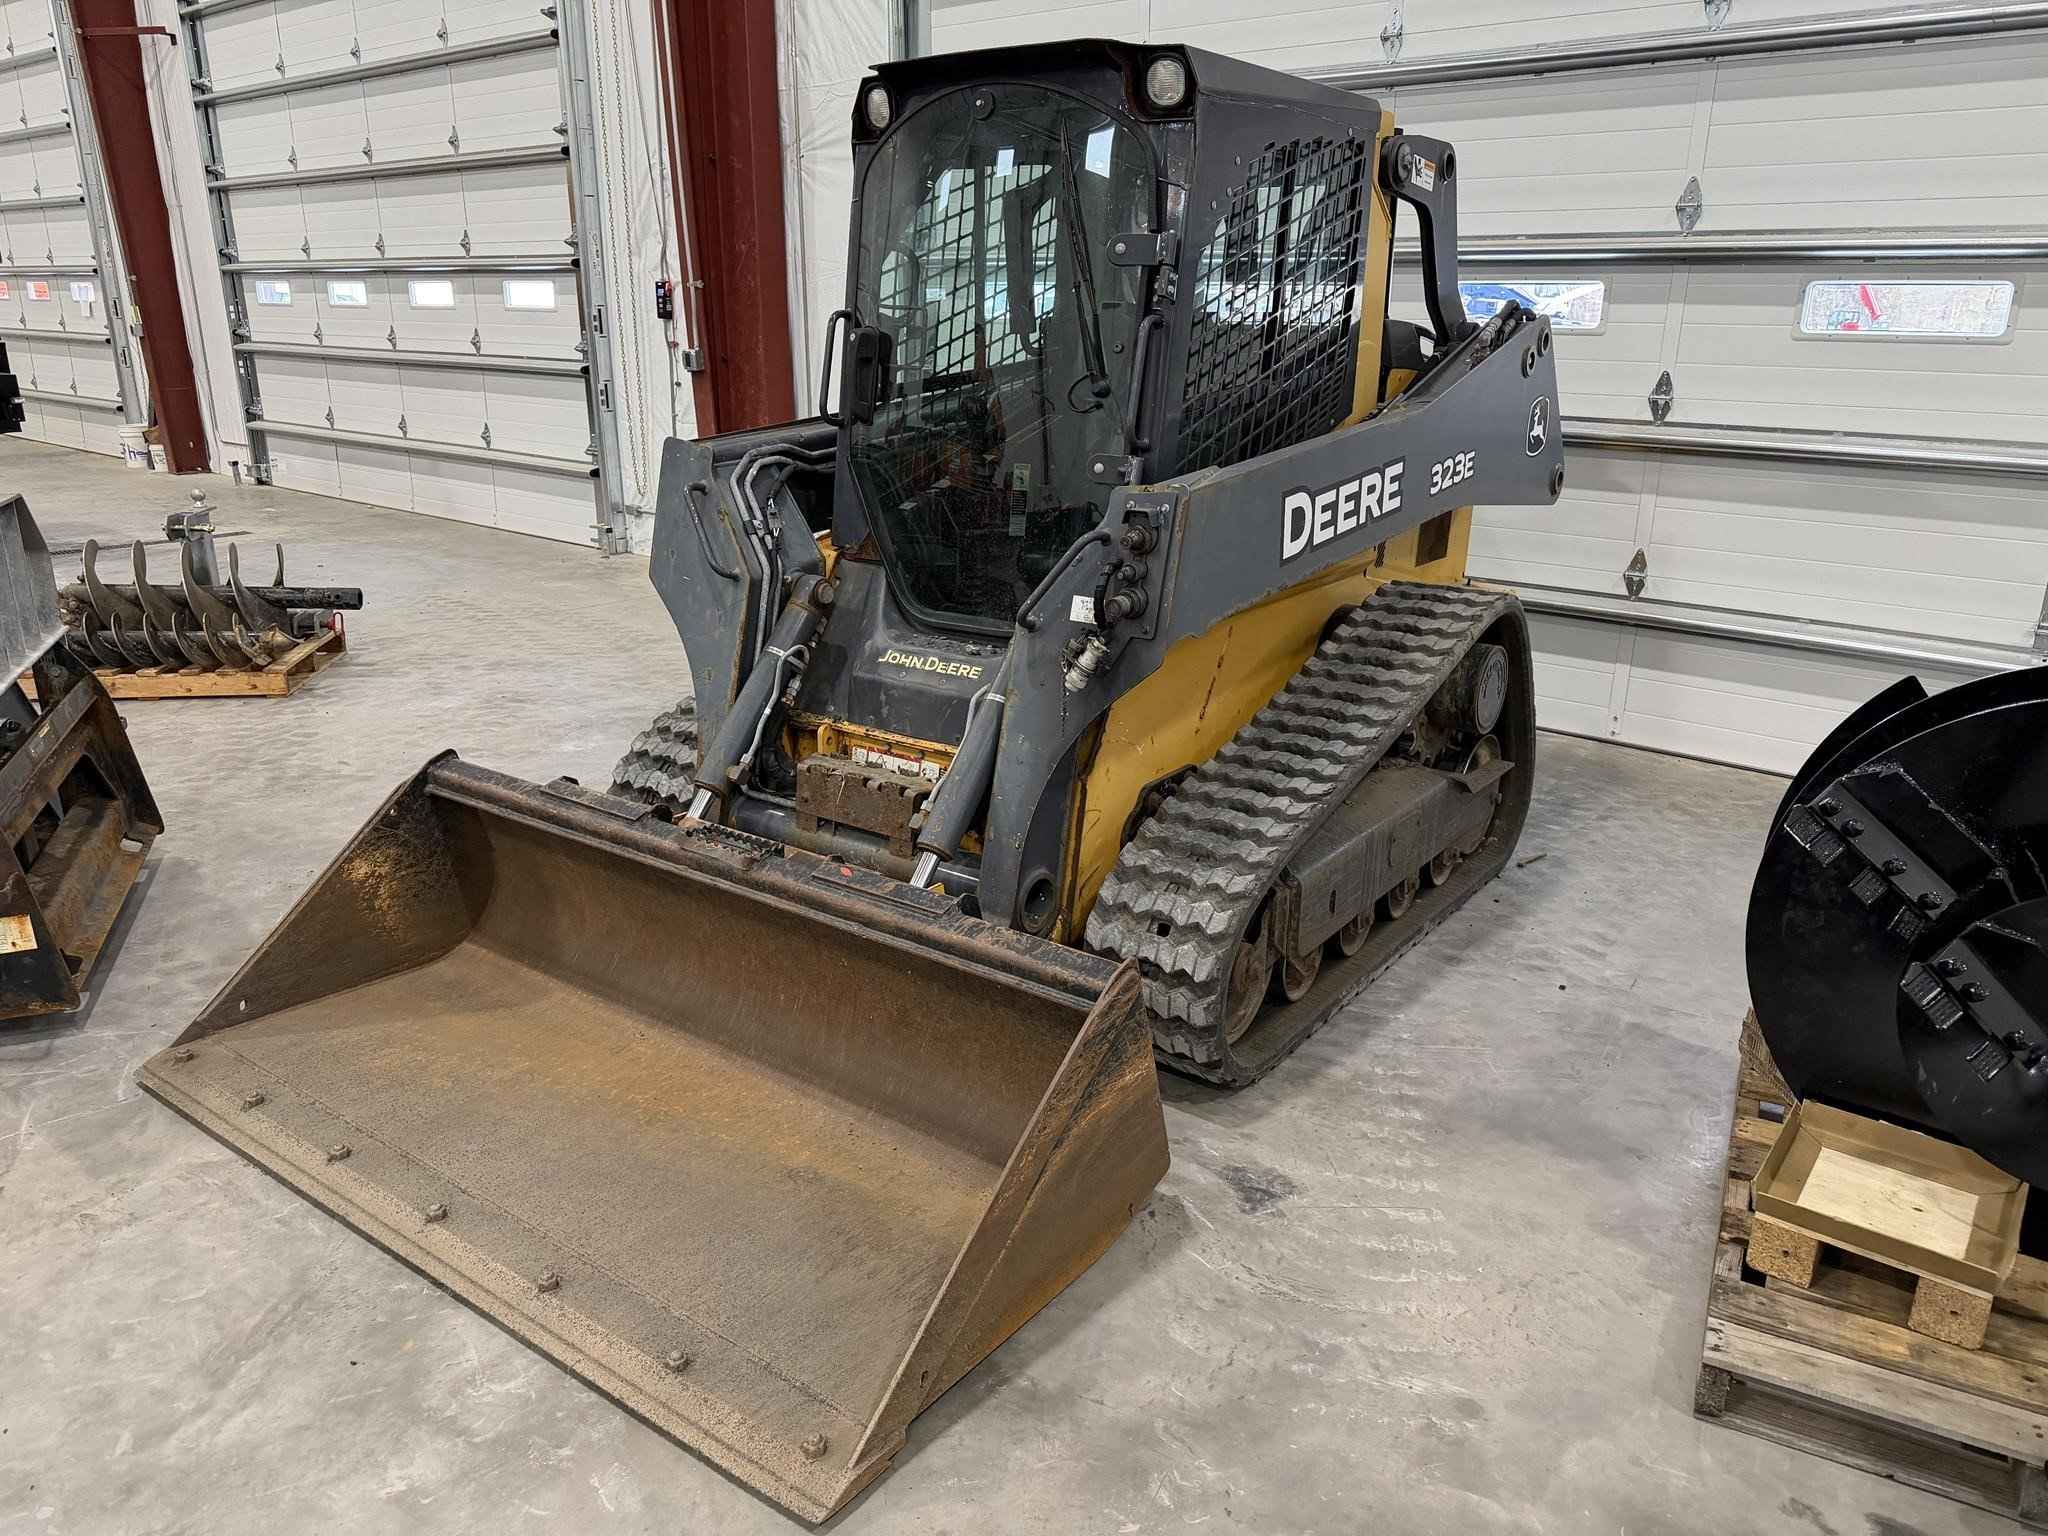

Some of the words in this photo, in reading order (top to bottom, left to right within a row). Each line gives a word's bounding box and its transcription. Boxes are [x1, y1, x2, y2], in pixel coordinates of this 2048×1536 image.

[1430, 451, 1475, 495] 323E
[1282, 462, 1403, 560] DEERE
[878, 649, 924, 670] JOHN
[925, 656, 982, 679] DEERE
